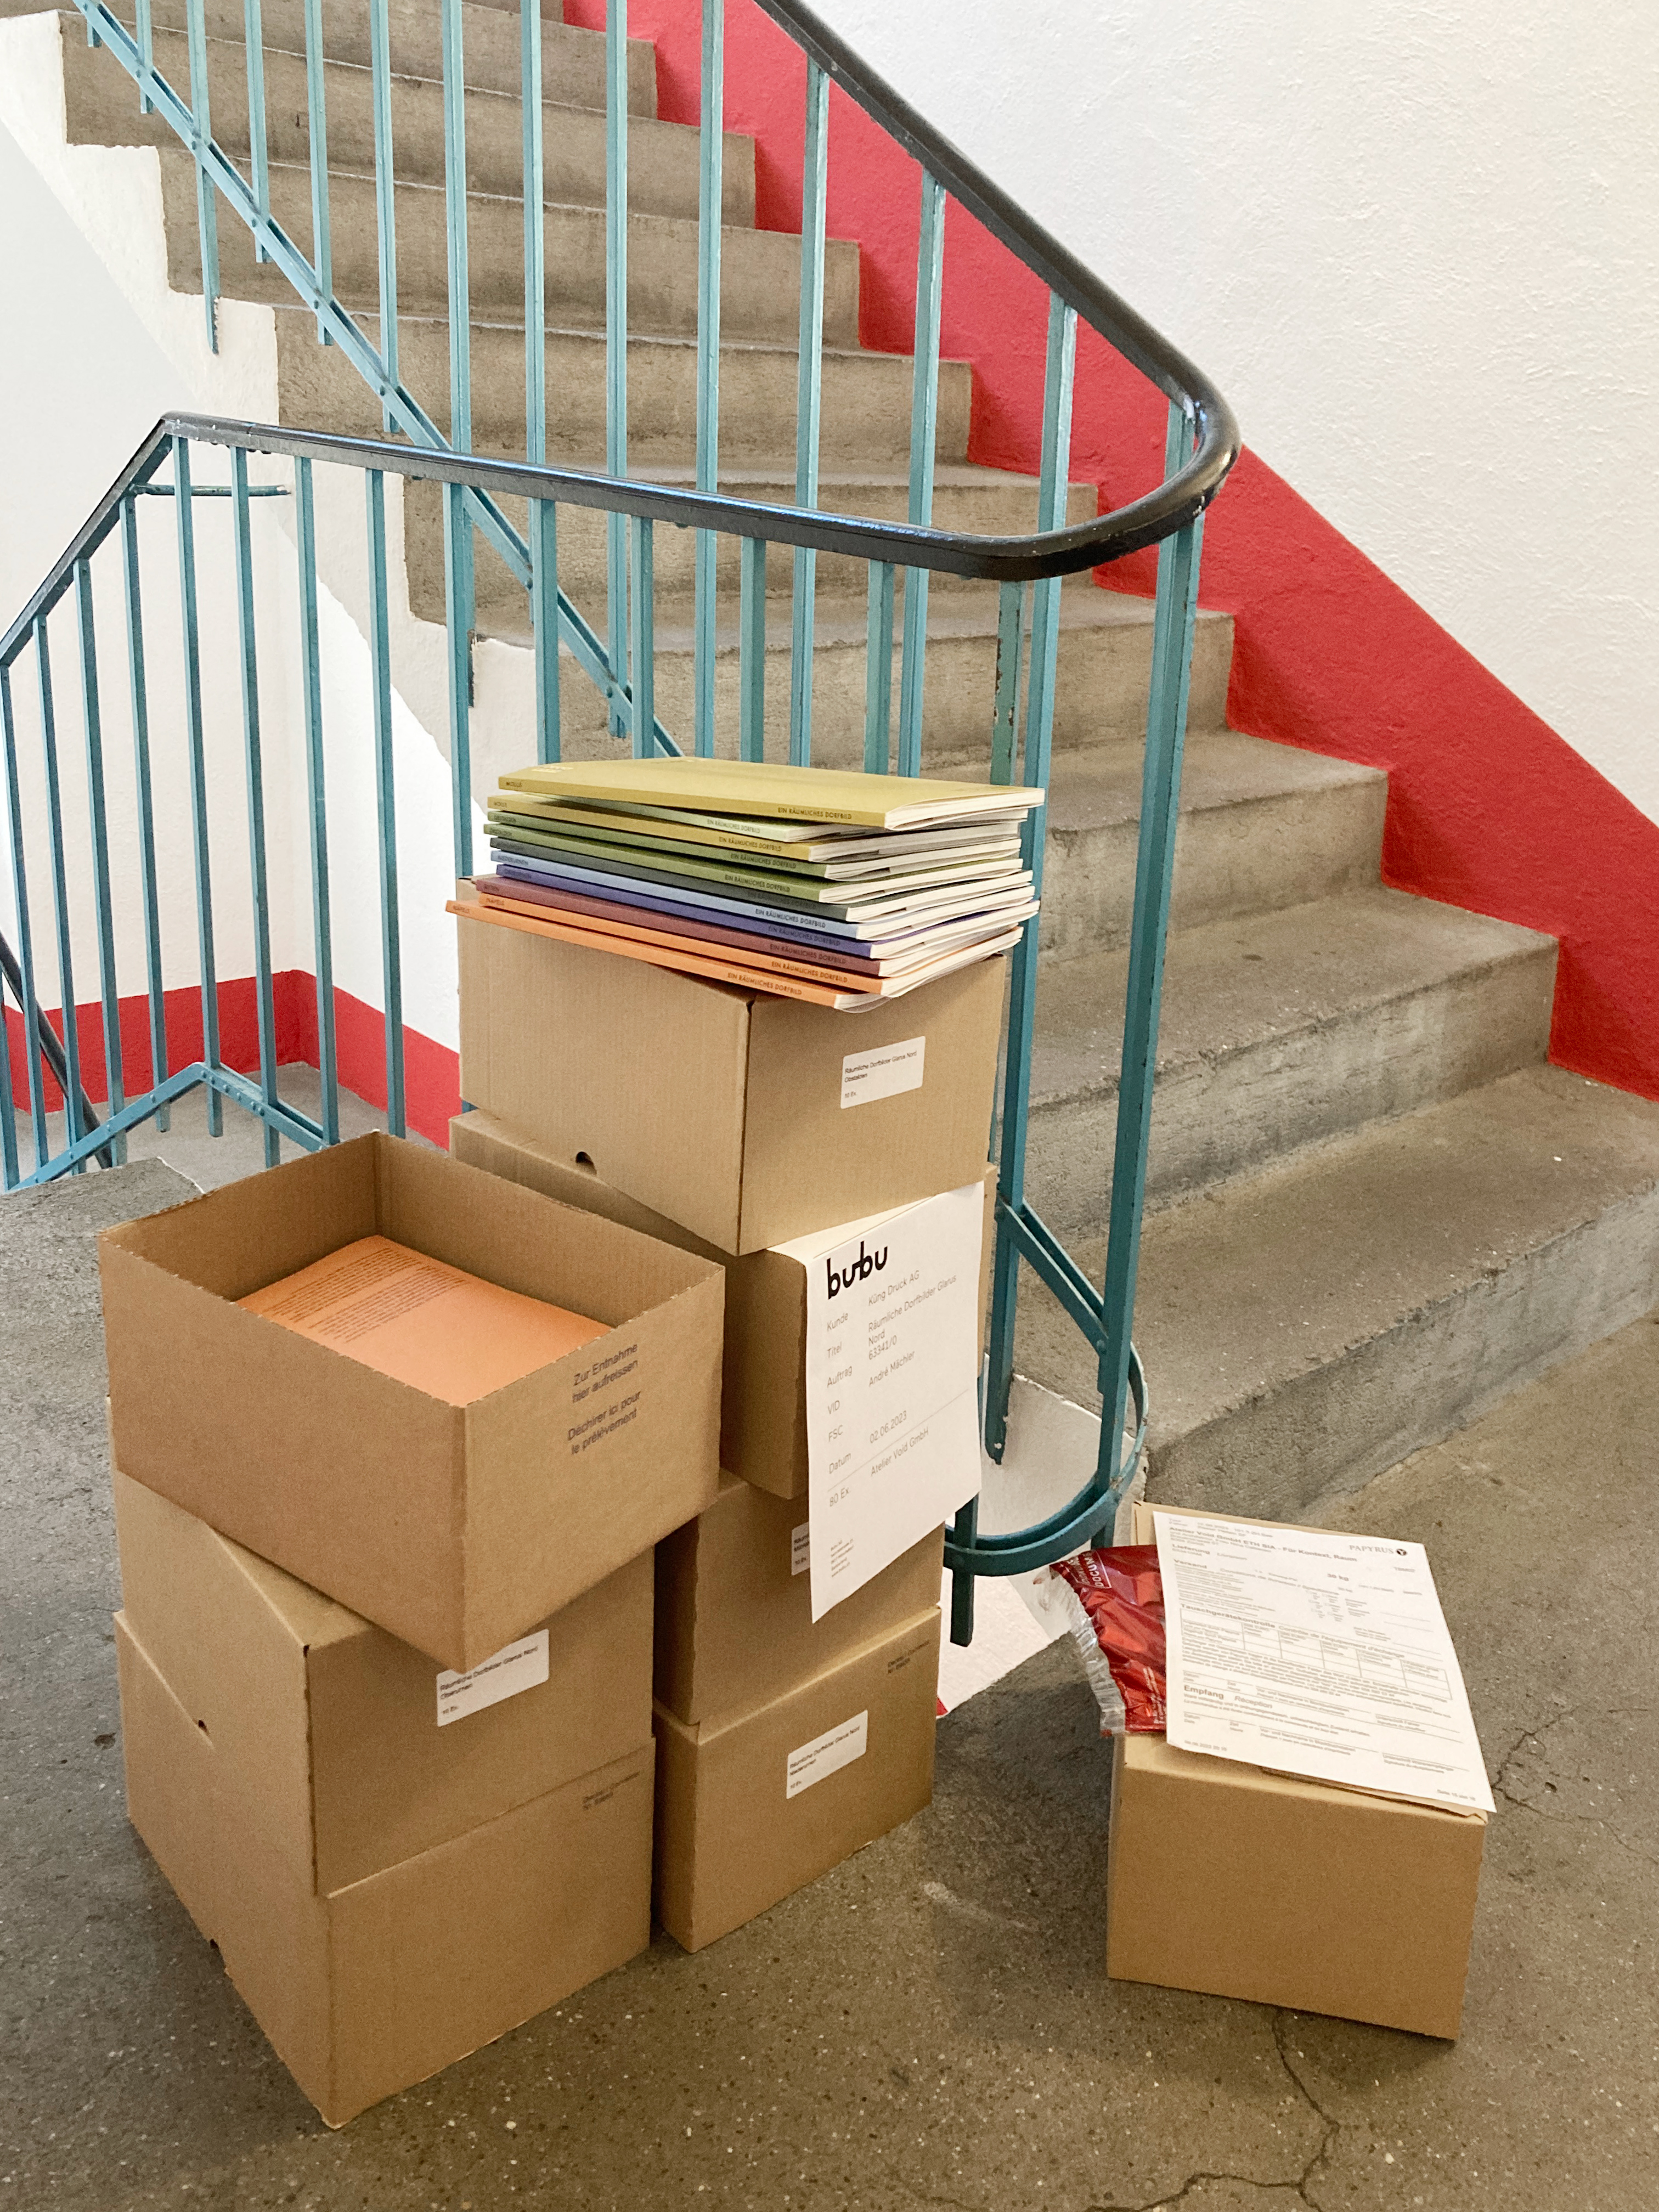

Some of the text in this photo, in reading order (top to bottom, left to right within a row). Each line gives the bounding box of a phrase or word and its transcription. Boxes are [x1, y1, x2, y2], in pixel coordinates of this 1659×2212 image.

[789, 808, 823, 817] RÄUMLICHES
[825, 811, 851, 820] DORFBILD
[728, 837, 758, 848] RÄUMLICHES
[759, 843, 782, 851] DORFBILD
[741, 854, 771, 865] RÄUMLICHES
[772, 860, 797, 869] DORFBILD
[734, 876, 765, 888] RÄUMLICHES
[766, 883, 790, 892] DORFBILD
[766, 910, 798, 923] RÄUMLICHES
[800, 917, 826, 928] DORFBILD
[781, 945, 817, 959] RÄUMLICHES
[819, 952, 847, 964] DORFBILD
[783, 963, 819, 977] RÄUMLICHES
[820, 971, 848, 983] DORFBILD
[739, 974, 773, 989] RÄUMLICHES
[775, 983, 802, 995] DORFBILD
[827, 1240, 888, 1300] bubu
[827, 1270, 919, 1331] Kunde Küng Druck AG
[827, 1275, 957, 1358] Titel Räumliche Dorfbilder Glarus
[868, 1329, 885, 1346] Nord
[574, 1344, 637, 1386] Zur Entnahme
[827, 1334, 898, 1387] Auftrag 63341/0
[572, 1360, 639, 1403] hier aufreissen
[827, 1350, 915, 1414] VID André Mächler
[609, 1405, 618, 1417] ici
[621, 1391, 641, 1410] pour
[828, 1425, 843, 1442] FSC
[829, 1410, 907, 1474] Datum 02.06.2023
[572, 1443, 580, 1455] le
[830, 1493, 838, 1507] 80
[871, 1455, 892, 1476] Atelier
[893, 1442, 909, 1459] Void
[910, 1426, 929, 1448] GmbH
[1216, 1534, 1241, 1543] GmbH
[1172, 1544, 1210, 1555] Lieferung
[1349, 1544, 1394, 1554] PAPYRUS
[1174, 1559, 1207, 1569] Versand
[1184, 1685, 1224, 1700] Empfang
[1234, 1695, 1273, 1709] Réception
